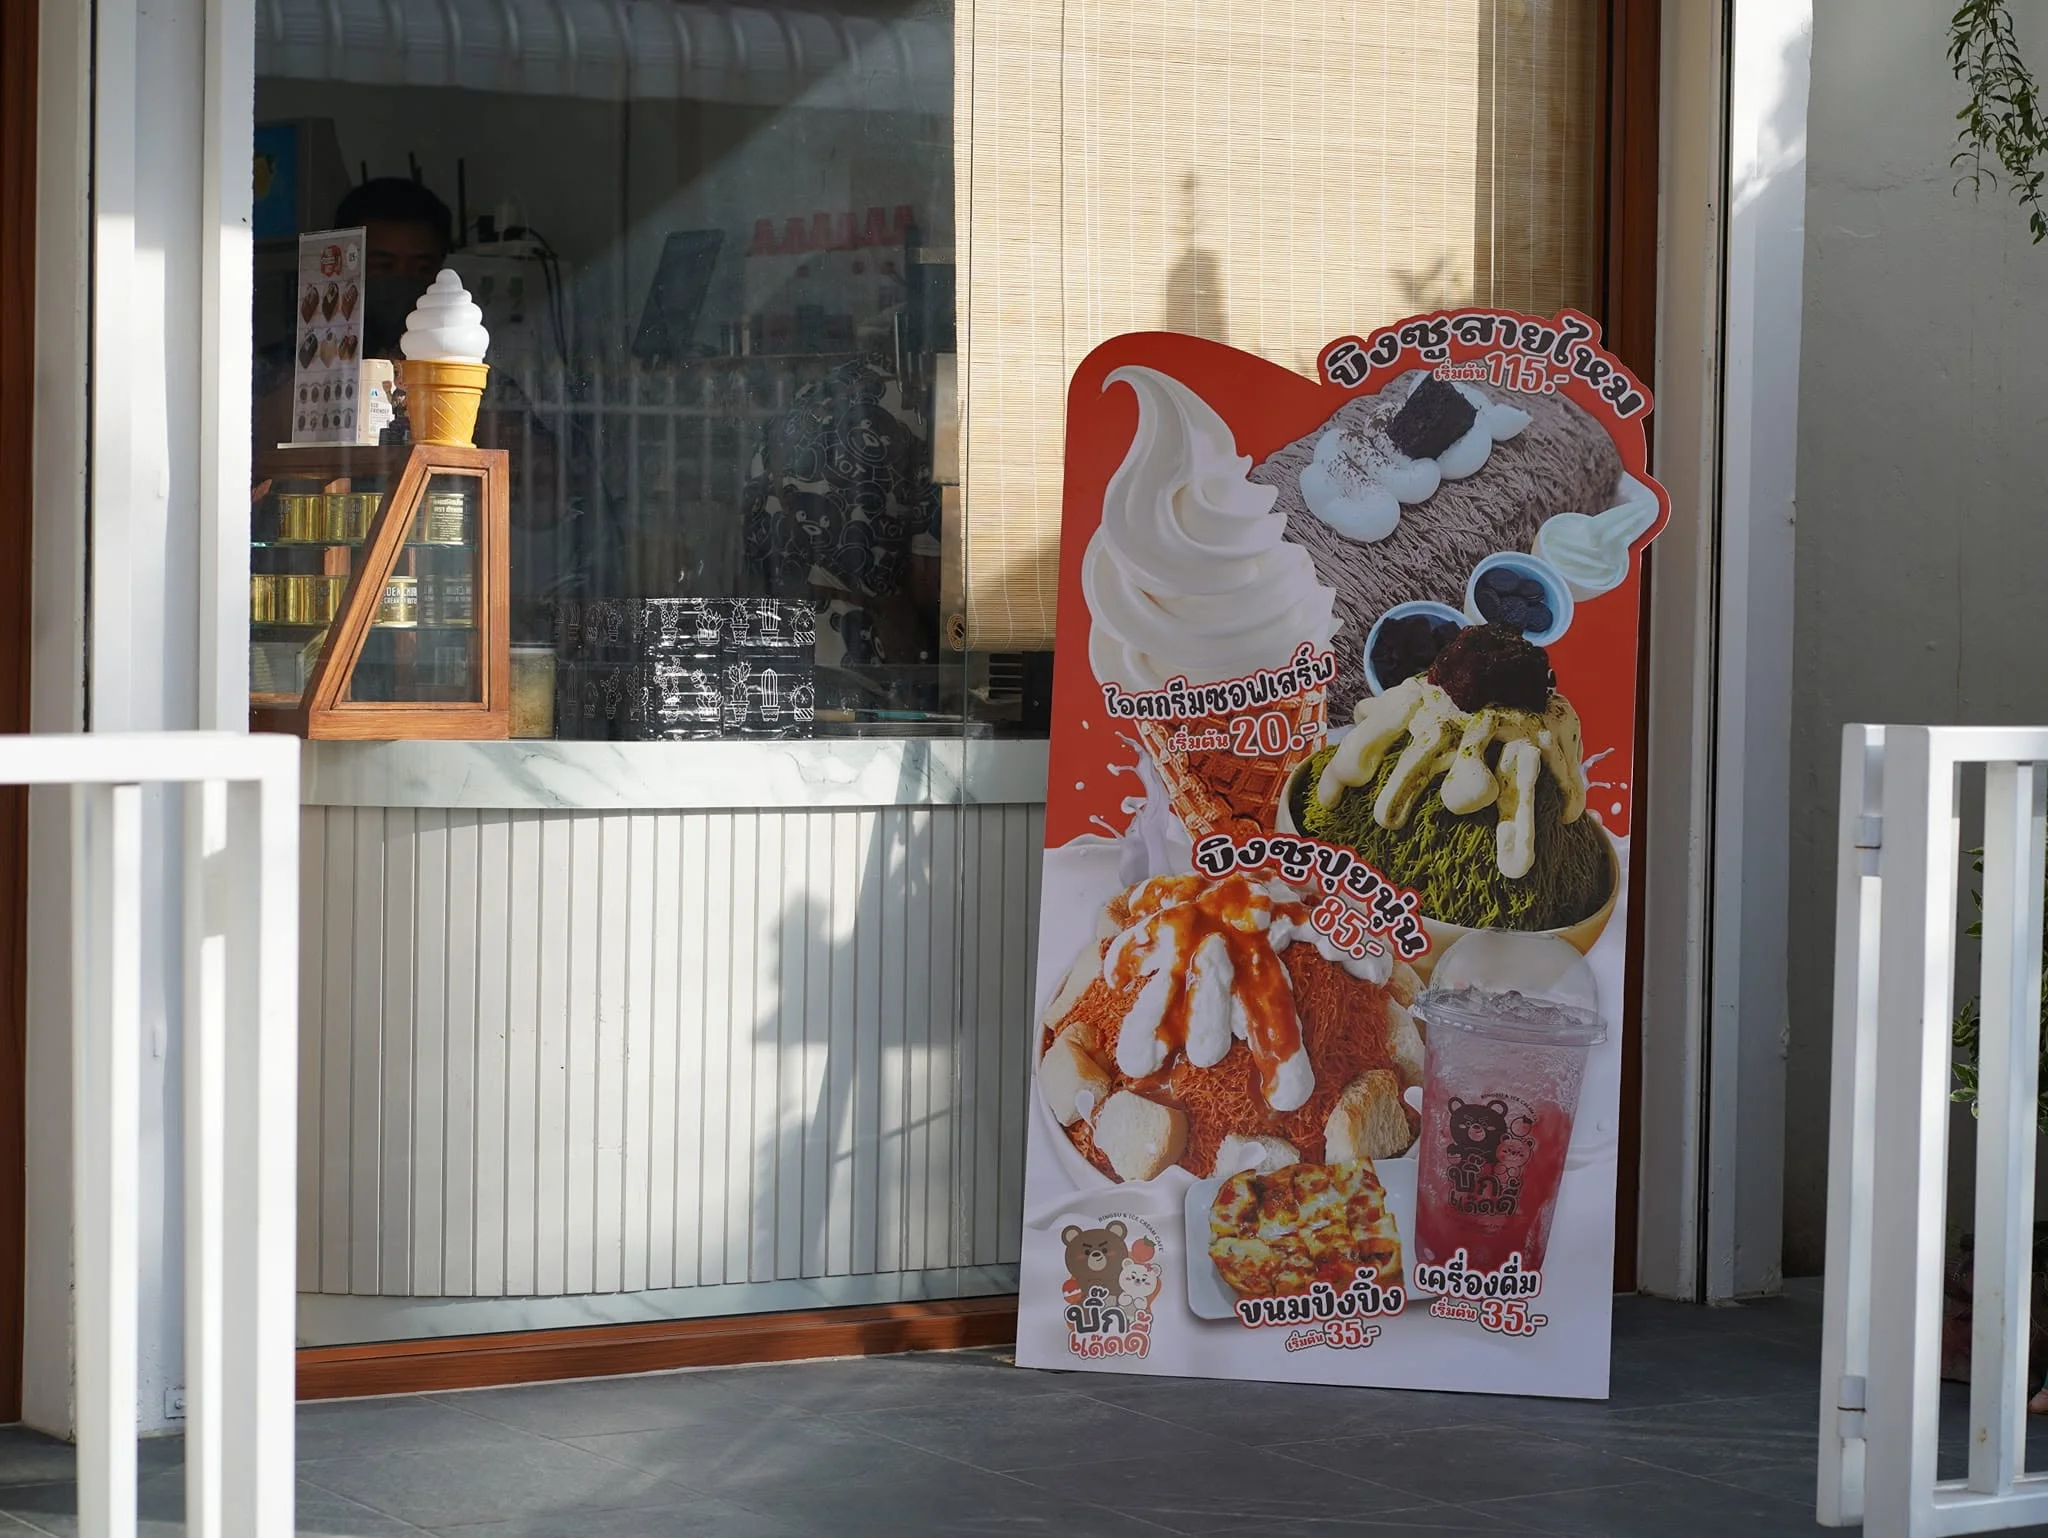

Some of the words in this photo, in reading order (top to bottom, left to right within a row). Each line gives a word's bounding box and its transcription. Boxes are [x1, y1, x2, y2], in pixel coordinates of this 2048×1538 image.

[1326, 314, 1644, 417] บิงซูสายไหม
[1434, 358, 1487, 380] เริ่มต้น
[1168, 725, 1229, 751] เริ่มต้น
[1199, 837, 1425, 955] บิงซูปุยนุ่น
[1128, 1213, 1140, 1221] ICE
[1418, 1252, 1537, 1296] เครื่องดื่ม
[1065, 1286, 1126, 1334] บิ๊ก
[1239, 1270, 1402, 1324] ขนมปังปิ้ง
[1430, 1297, 1477, 1320] เริ่มต้น
[1286, 1331, 1324, 1350] เริ่มต้น
